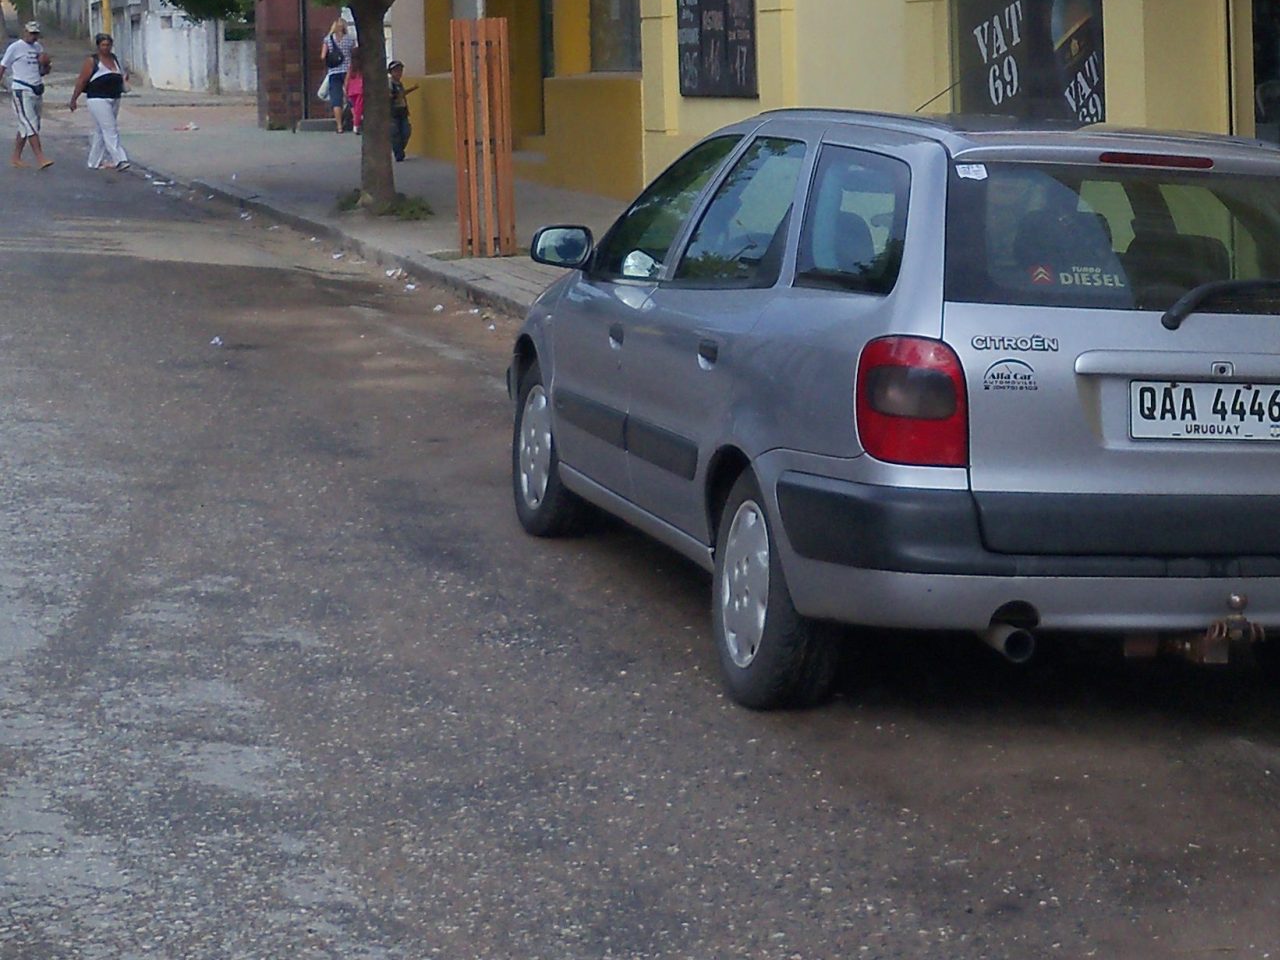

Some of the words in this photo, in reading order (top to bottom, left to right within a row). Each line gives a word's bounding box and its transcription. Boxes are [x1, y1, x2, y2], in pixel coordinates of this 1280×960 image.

[973, 0, 1023, 64] VAT
[989, 55, 1019, 106] 69
[1064, 51, 1100, 112] VAT
[1059, 272, 1125, 288] DIESEL
[971, 334, 1059, 352] CITROËN
[988, 372, 1010, 380] Alfa
[1013, 372, 1033, 381] Car
[1139, 386, 1197, 421] QAA
[1185, 424, 1240, 435] URUGUAY
